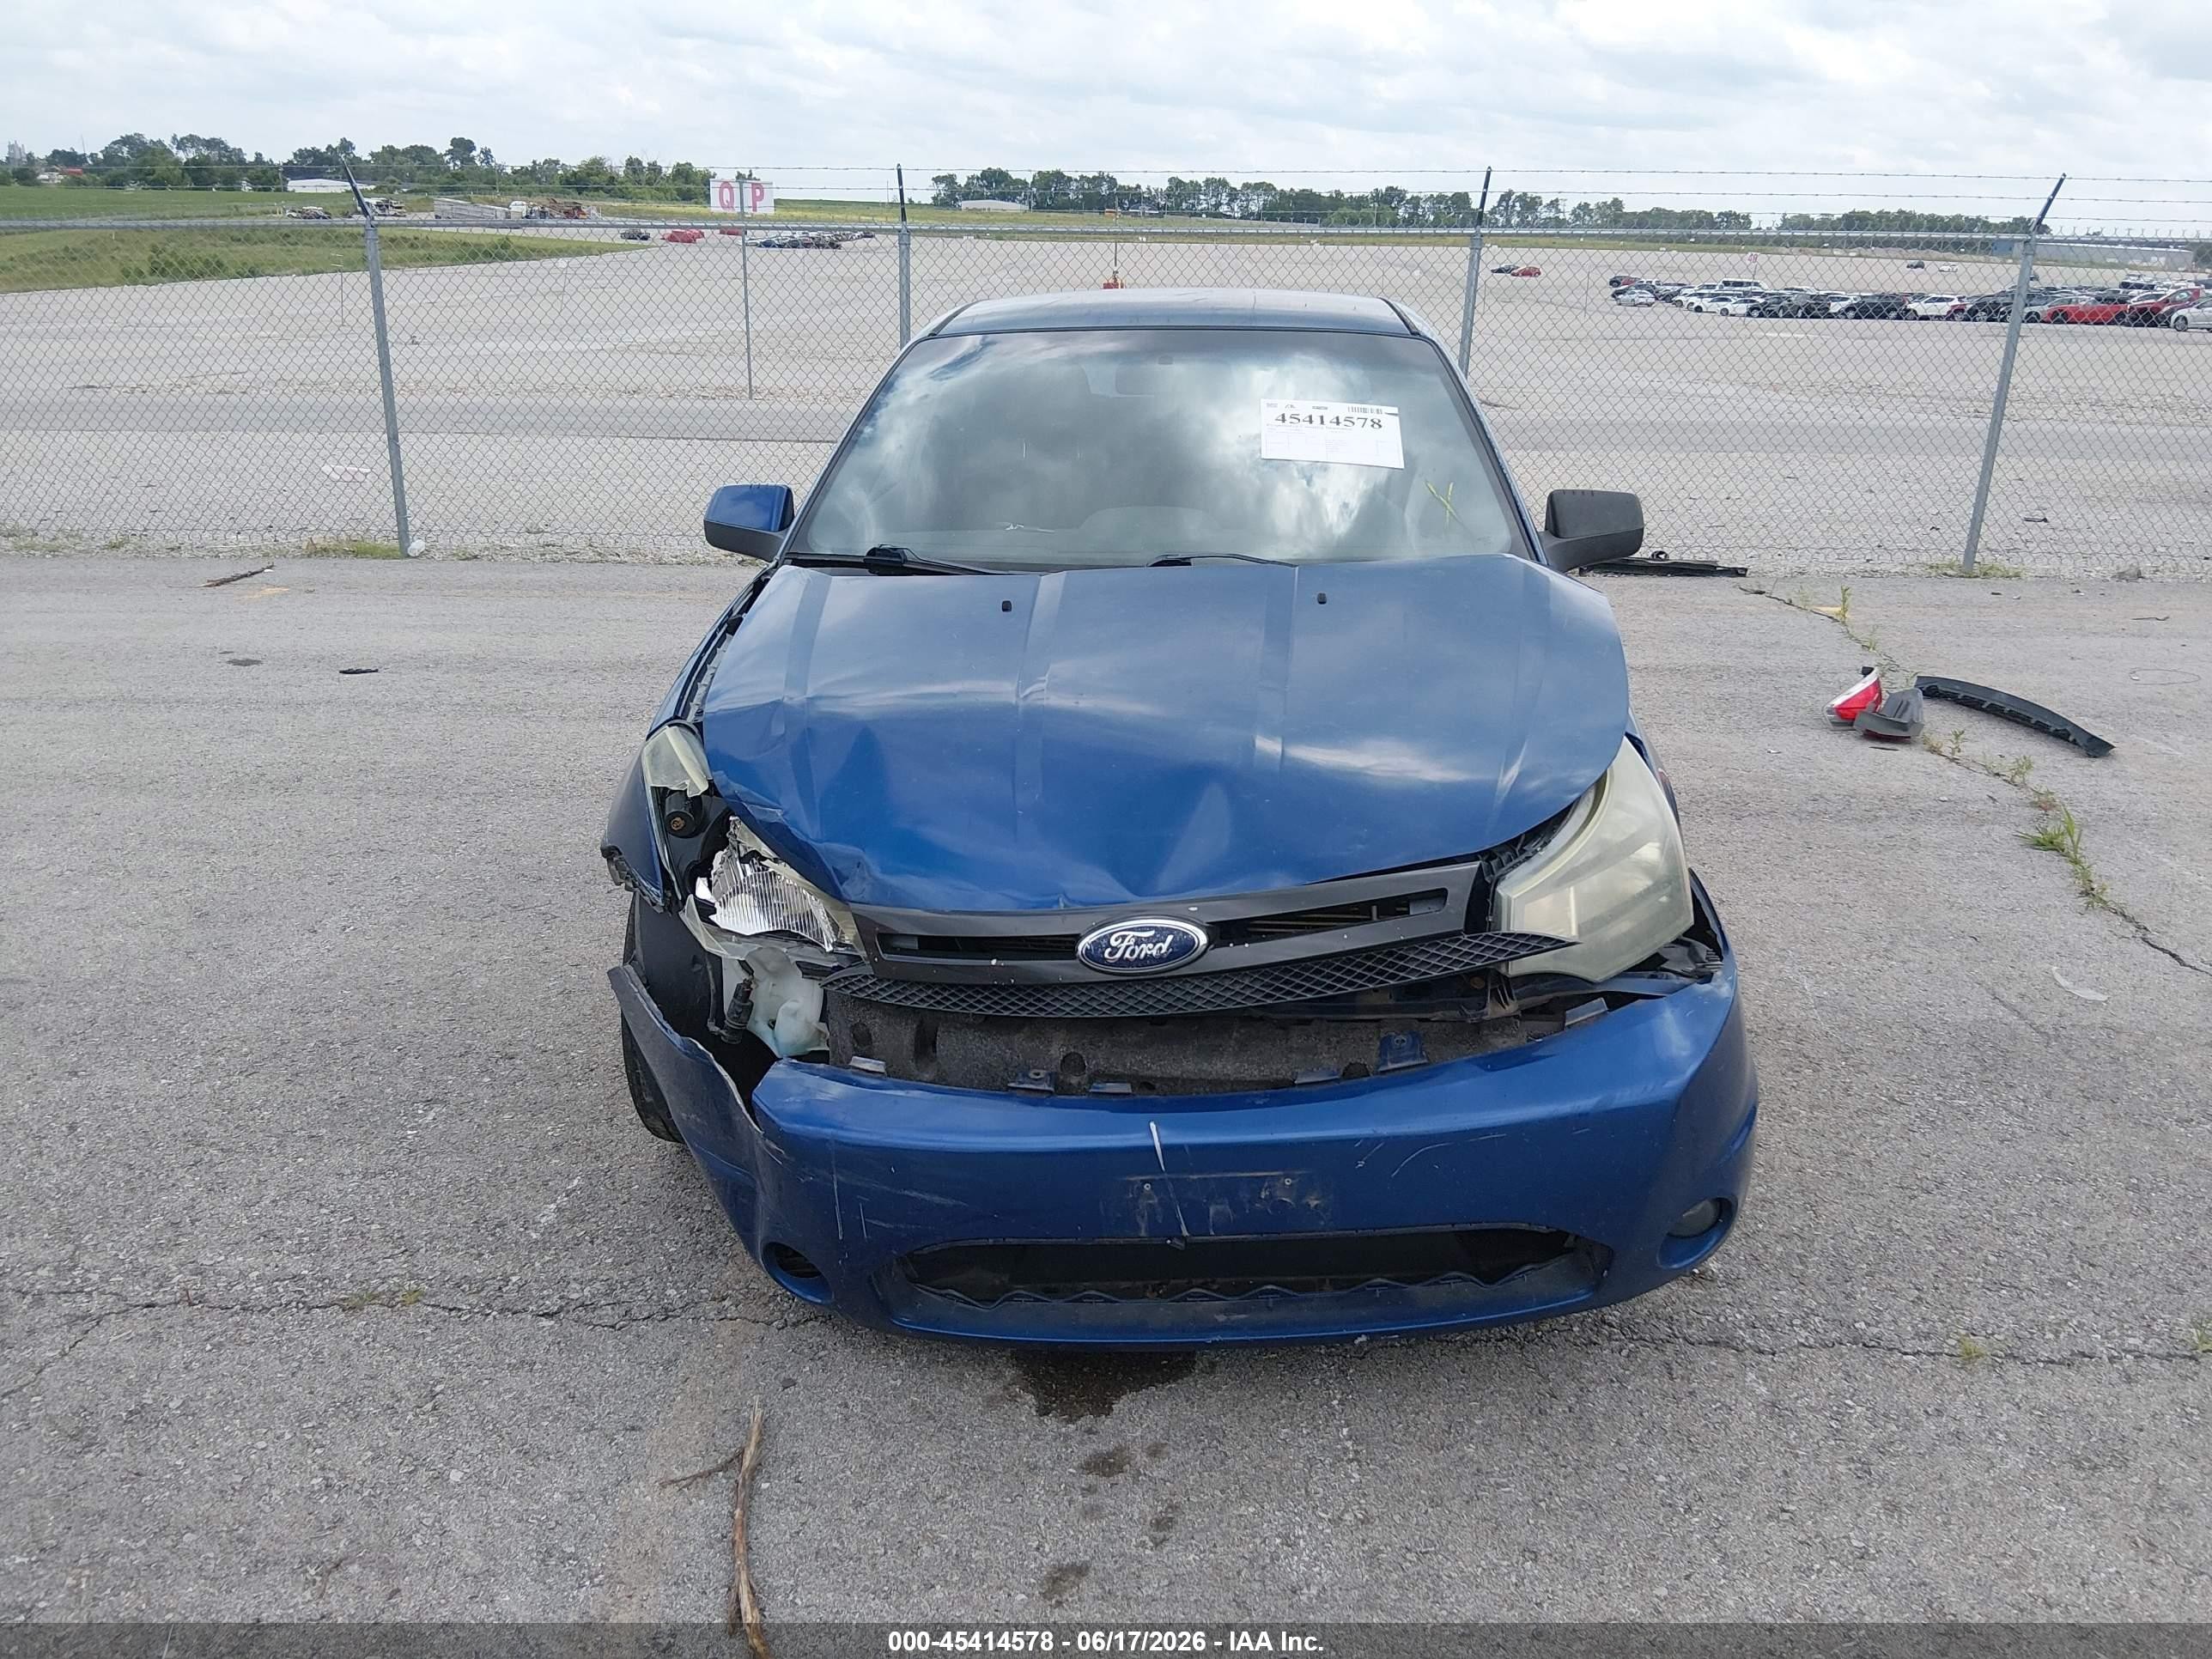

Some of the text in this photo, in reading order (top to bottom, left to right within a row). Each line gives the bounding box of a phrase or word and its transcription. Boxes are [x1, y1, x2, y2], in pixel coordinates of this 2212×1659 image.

[718, 180, 765, 212] Q P
[1274, 412, 1383, 429] 45414578
[1103, 929, 1174, 963] Ford
